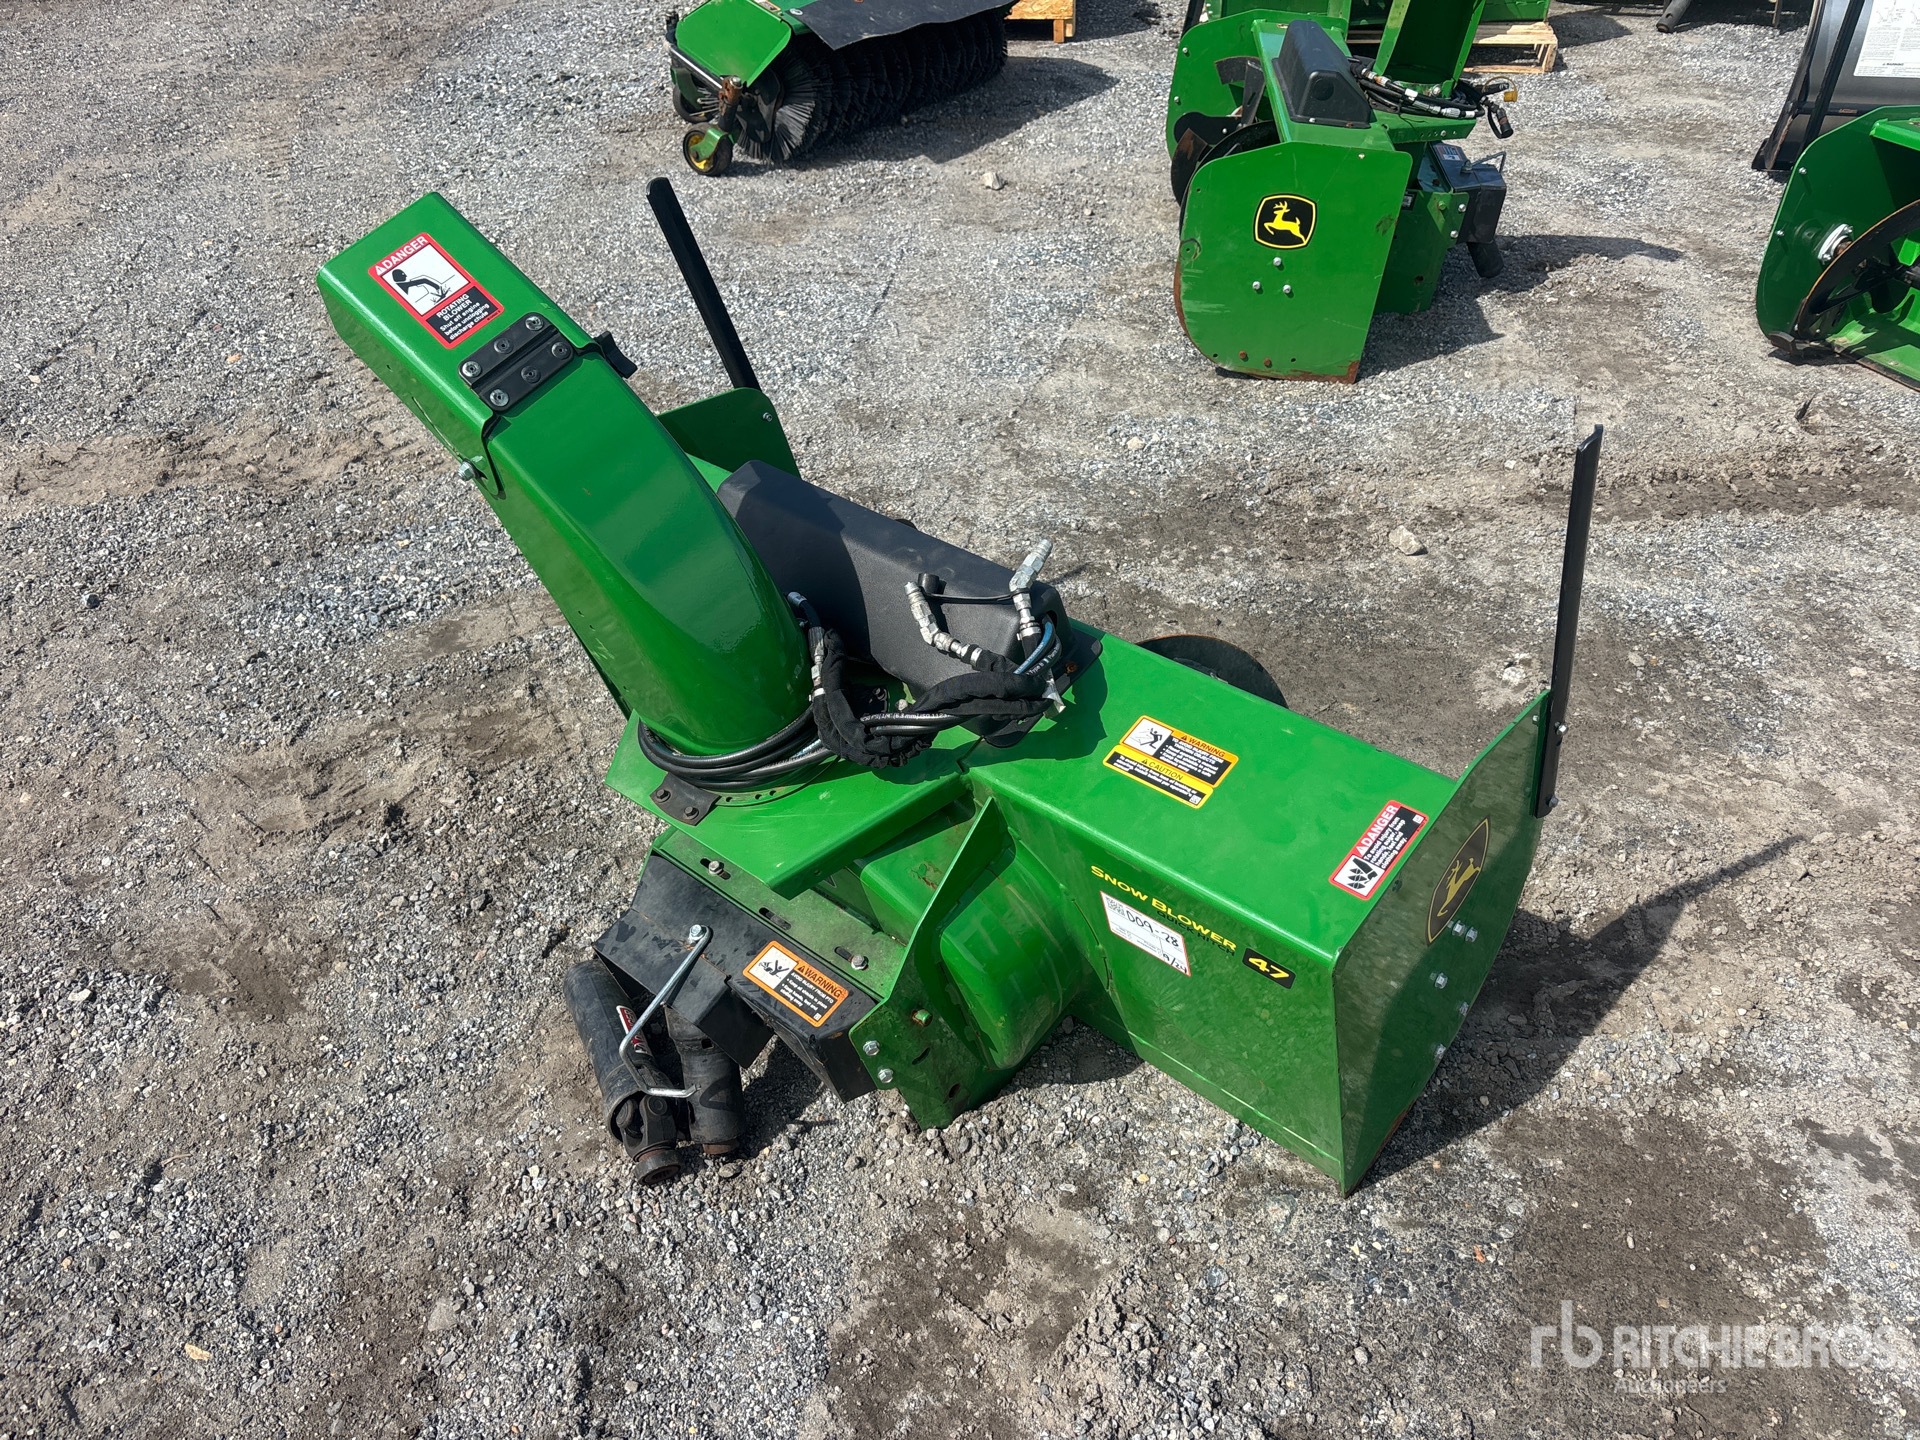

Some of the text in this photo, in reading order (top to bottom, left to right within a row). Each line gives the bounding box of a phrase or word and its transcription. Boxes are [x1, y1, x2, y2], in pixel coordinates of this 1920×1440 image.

[382, 236, 428, 269] DANGER
[436, 294, 469, 317] ROTATING
[440, 320, 454, 331] Shut
[462, 302, 481, 317] engine
[443, 299, 472, 321] BLOWER
[445, 322, 461, 336] before
[461, 303, 489, 324] unclogging
[449, 321, 475, 340] discharge
[474, 311, 488, 322] chute
[1189, 737, 1226, 758] WARNING
[1149, 761, 1183, 781] CAUTION
[1360, 805, 1398, 846] DANGER
[1365, 816, 1399, 861] To avoid injury from
[1370, 845, 1386, 864] rotating
[1091, 865, 1148, 901] SNOW
[1152, 898, 1236, 951] BLOWER
[1157, 911, 1235, 956] QUICK HITCH
[805, 967, 843, 998] WARNING
[1248, 957, 1290, 979] 47
